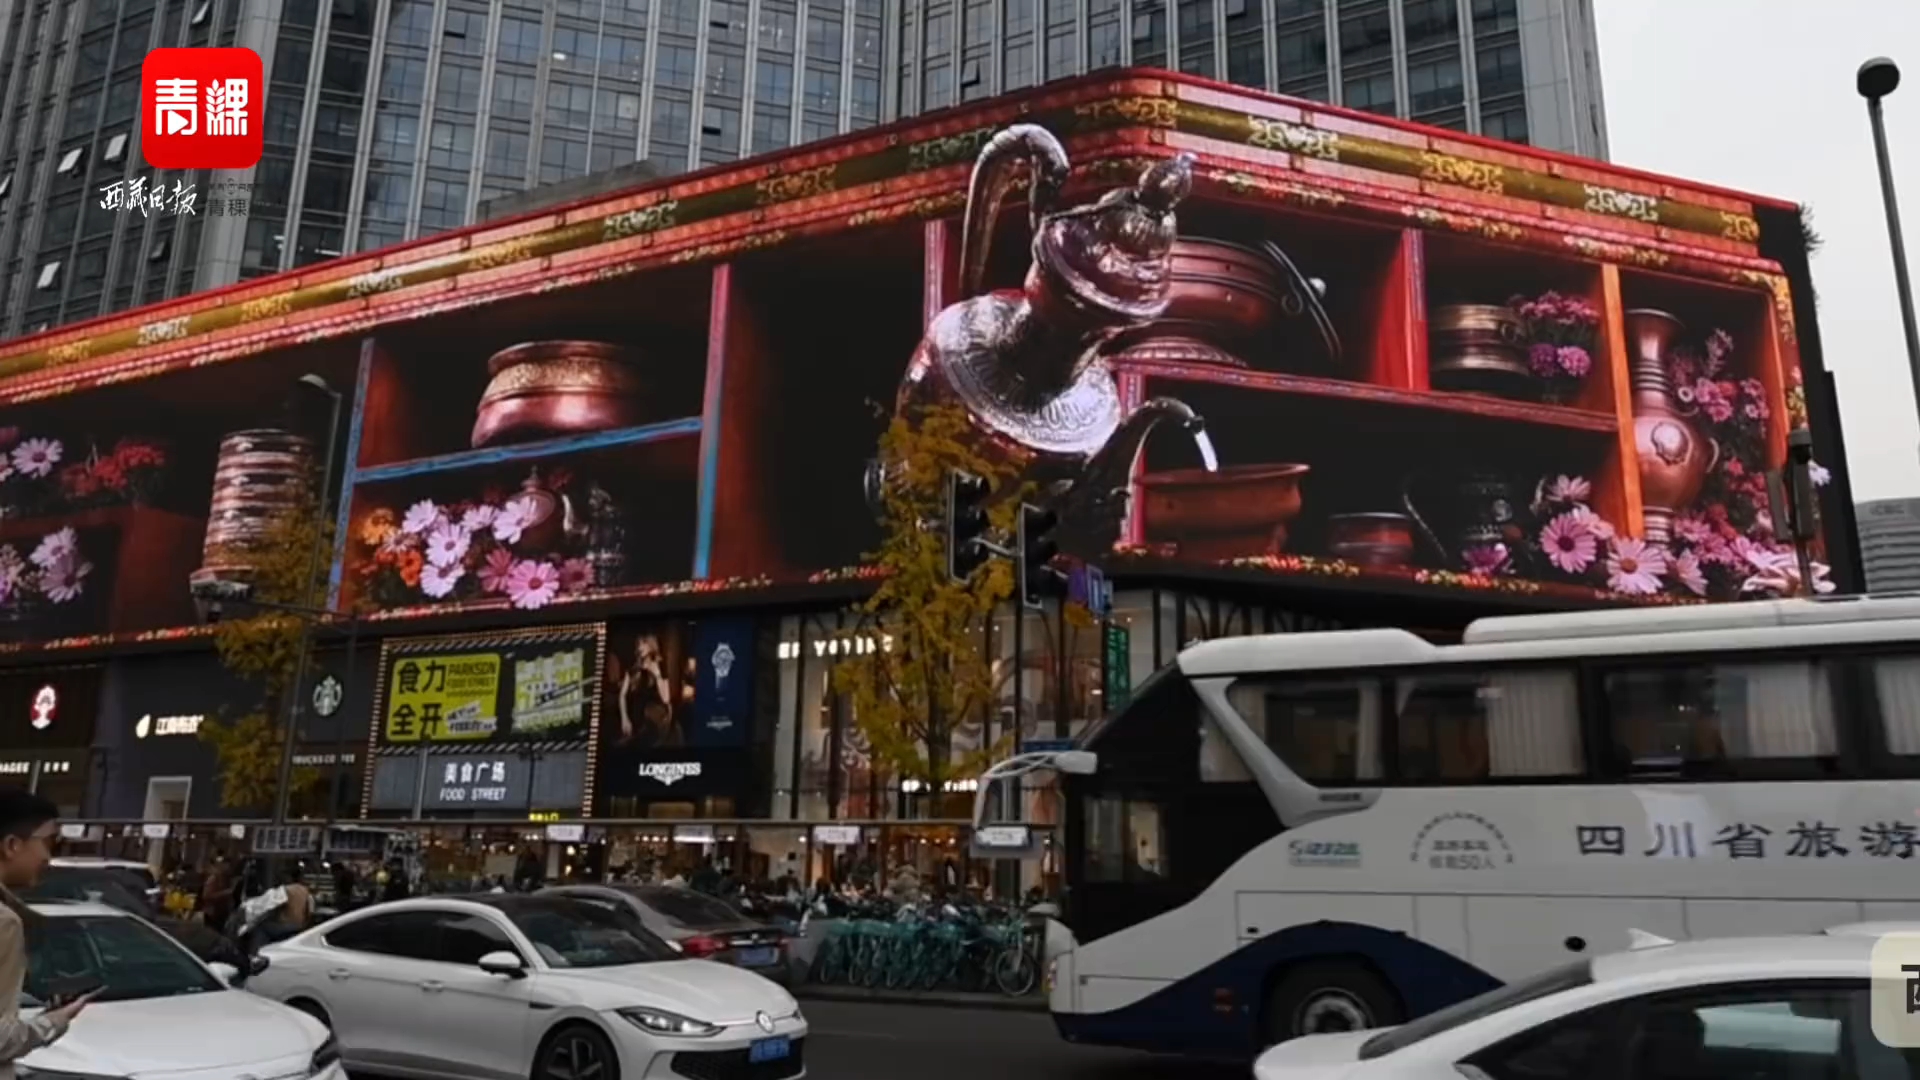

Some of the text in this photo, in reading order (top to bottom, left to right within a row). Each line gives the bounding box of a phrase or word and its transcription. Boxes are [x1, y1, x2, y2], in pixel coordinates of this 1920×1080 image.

[397, 660, 447, 695] 食力
[391, 703, 443, 738] 全开
[444, 761, 506, 784] 美食广场
[638, 761, 702, 777] LONGINES
[440, 786, 507, 802] FOOD STREET
[1576, 820, 1920, 860] 四川省旅游
